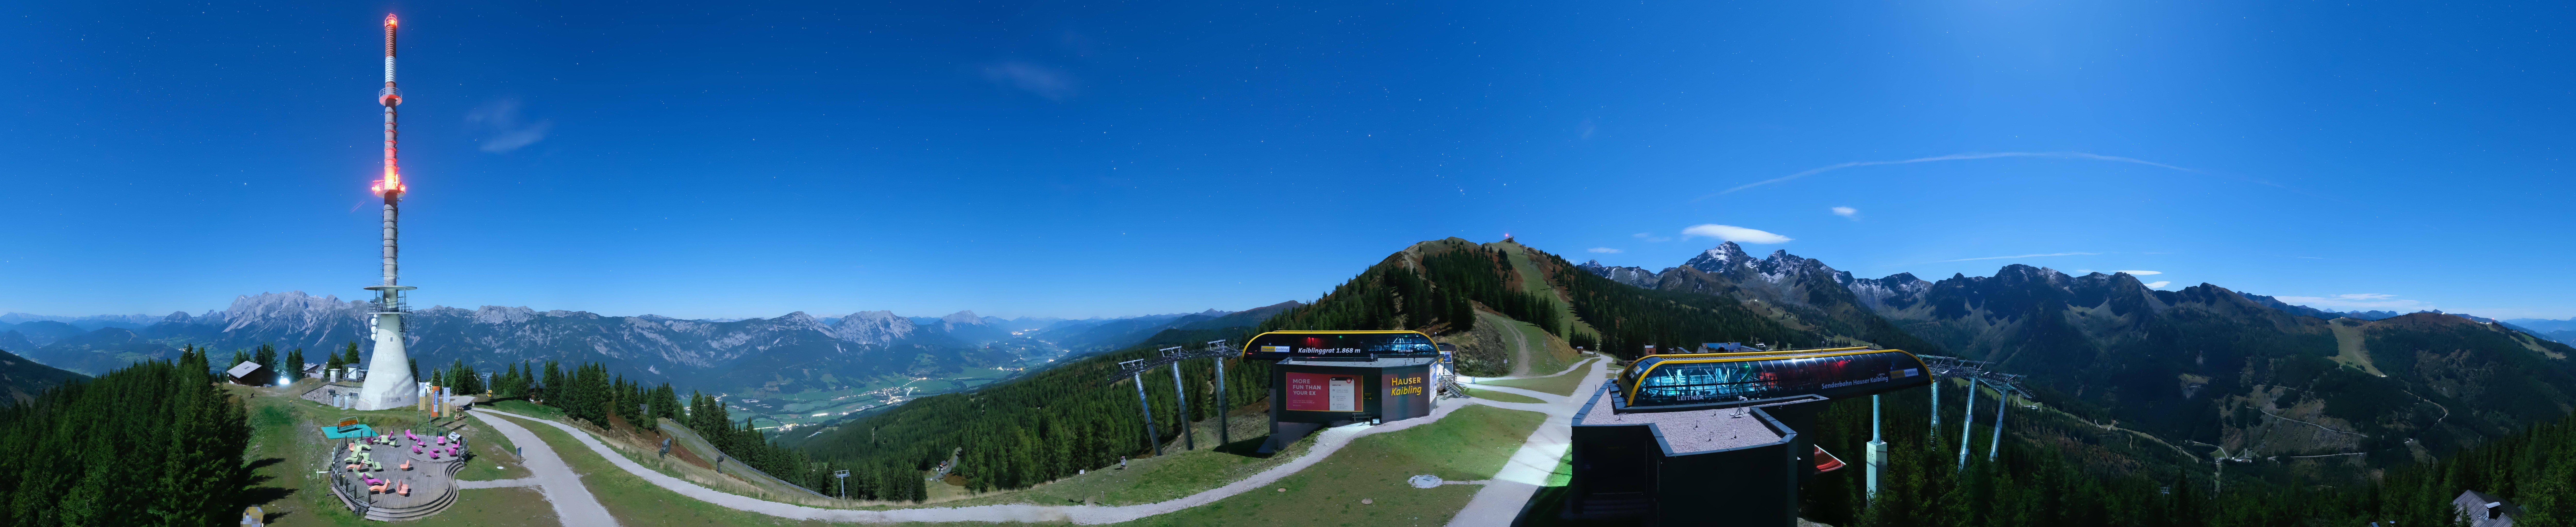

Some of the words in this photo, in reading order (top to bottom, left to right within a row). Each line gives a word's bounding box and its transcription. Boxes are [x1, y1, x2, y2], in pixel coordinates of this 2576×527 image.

[1392, 377, 1421, 386] HAUSER
[1822, 380, 1852, 389] Senderbahn
[1391, 386, 1422, 396] Kaibling
